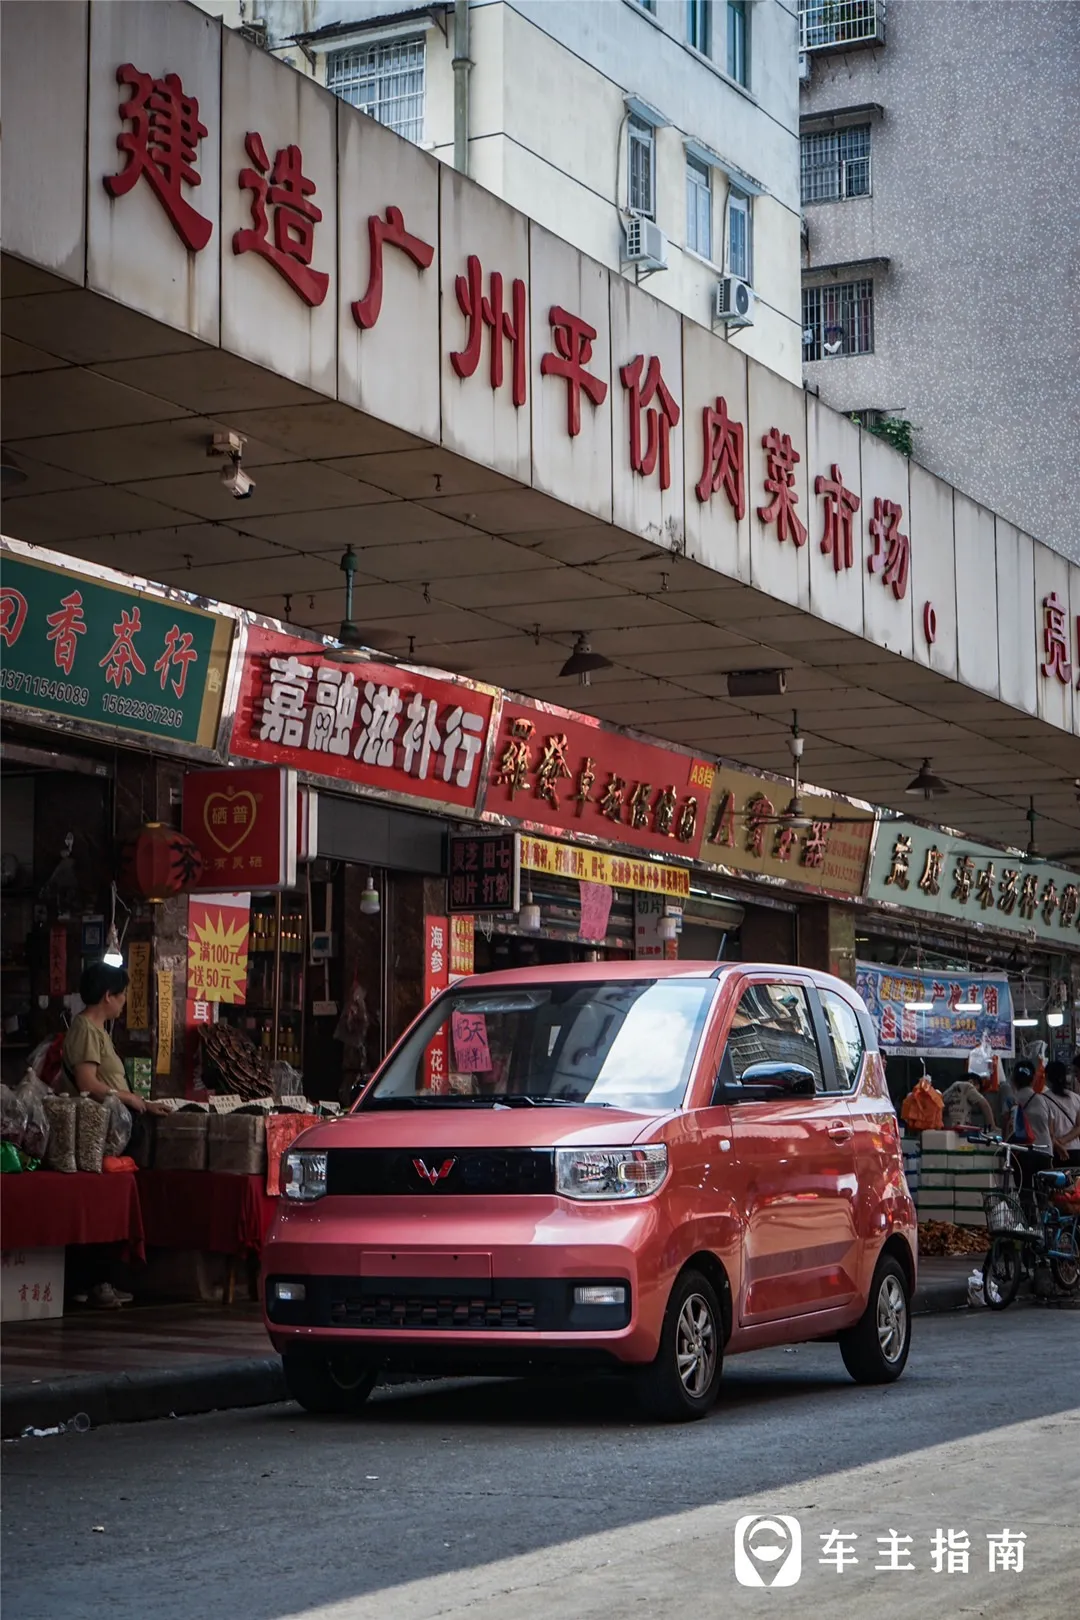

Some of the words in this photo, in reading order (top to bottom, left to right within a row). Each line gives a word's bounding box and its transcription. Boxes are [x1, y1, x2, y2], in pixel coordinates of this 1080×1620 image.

[1041, 591, 1080, 693] 亮
[0, 668, 90, 706] 13711546089
[102, 693, 182, 728] 15622387296
[260, 656, 484, 788] 嘉融滋补行
[199, 941, 241, 966] 满100元
[430, 926, 443, 973] 海参
[193, 965, 232, 989] 送50元
